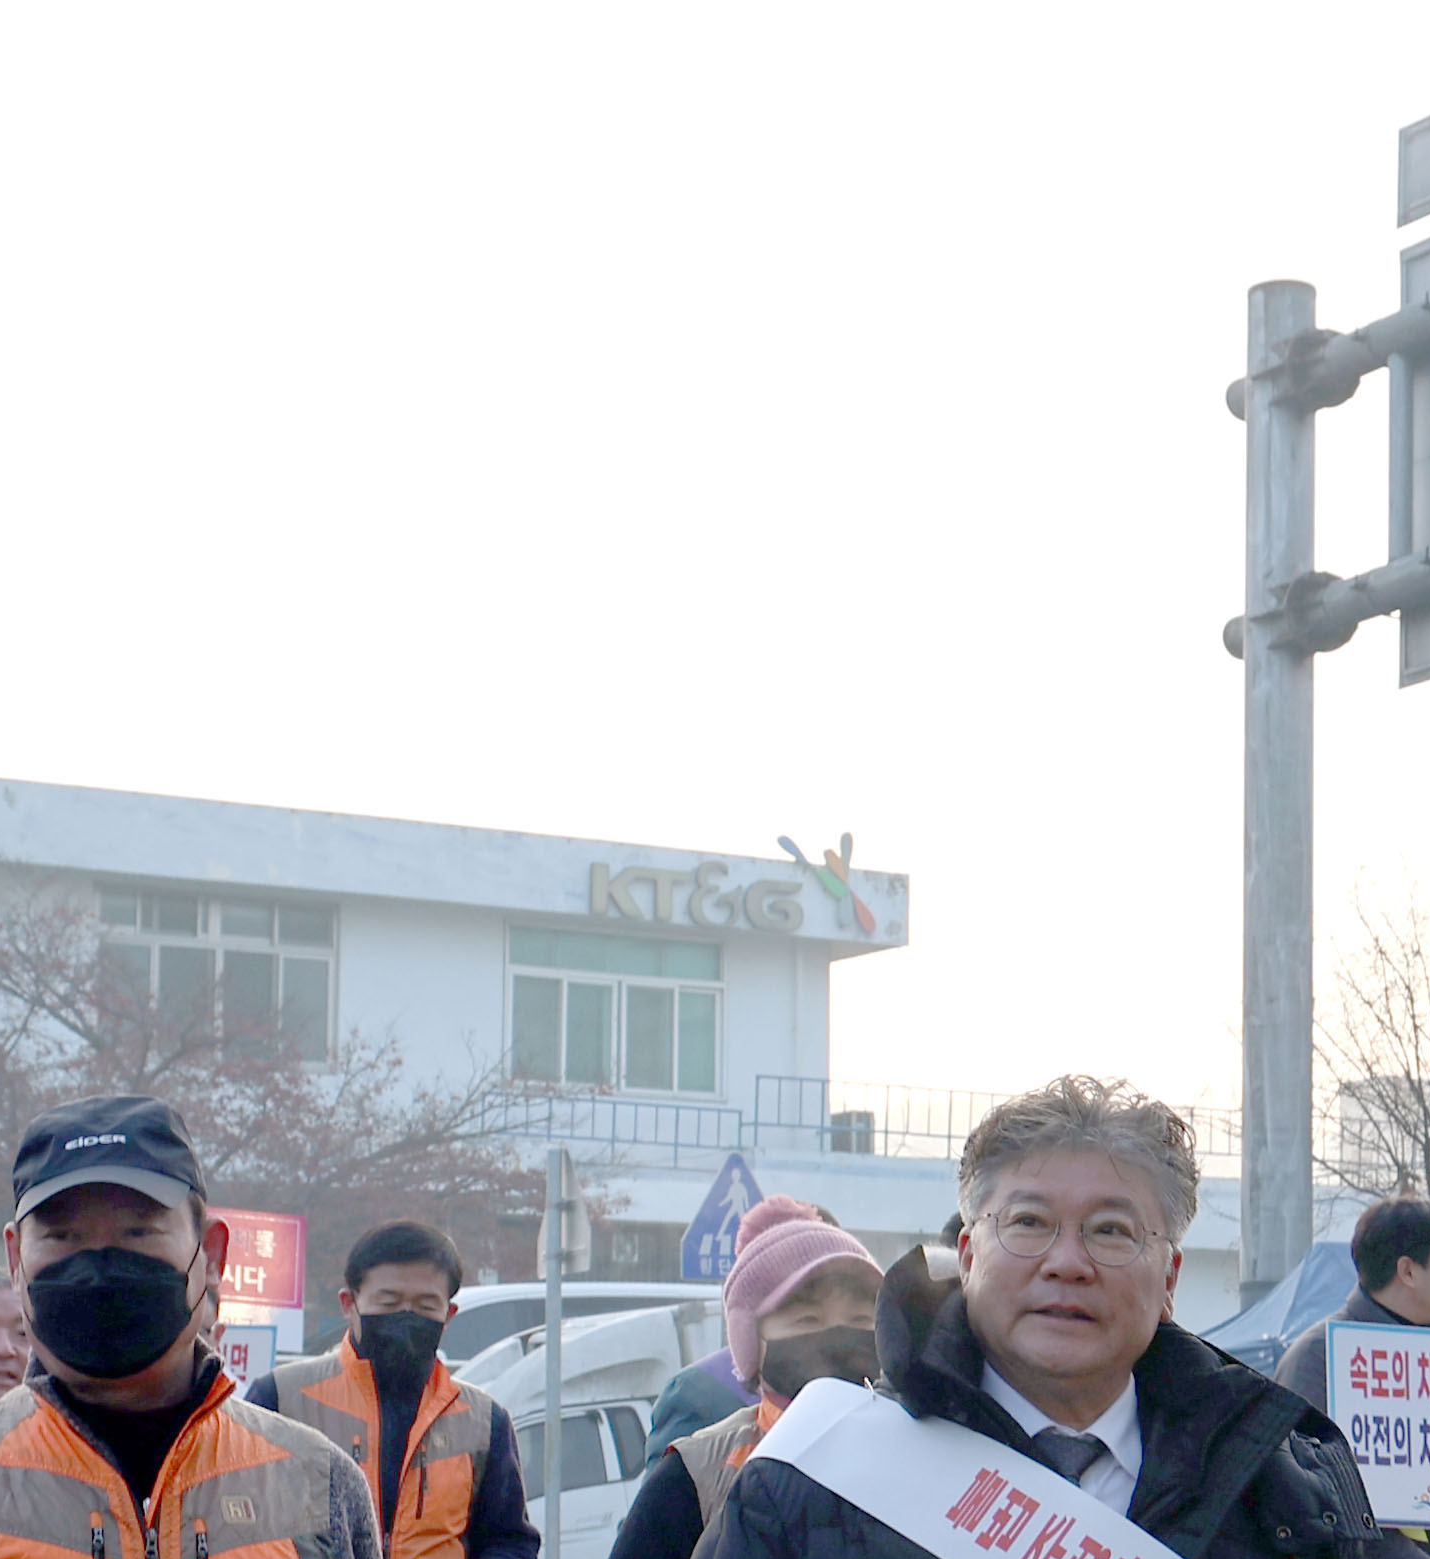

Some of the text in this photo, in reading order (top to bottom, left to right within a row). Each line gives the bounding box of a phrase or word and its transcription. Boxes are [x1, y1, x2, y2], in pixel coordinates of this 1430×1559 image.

[590, 860, 804, 933] KT&G
[1350, 1347, 1410, 1400] 속도의
[1351, 1413, 1412, 1467] 안전의
[945, 1467, 1041, 1552] 불법
